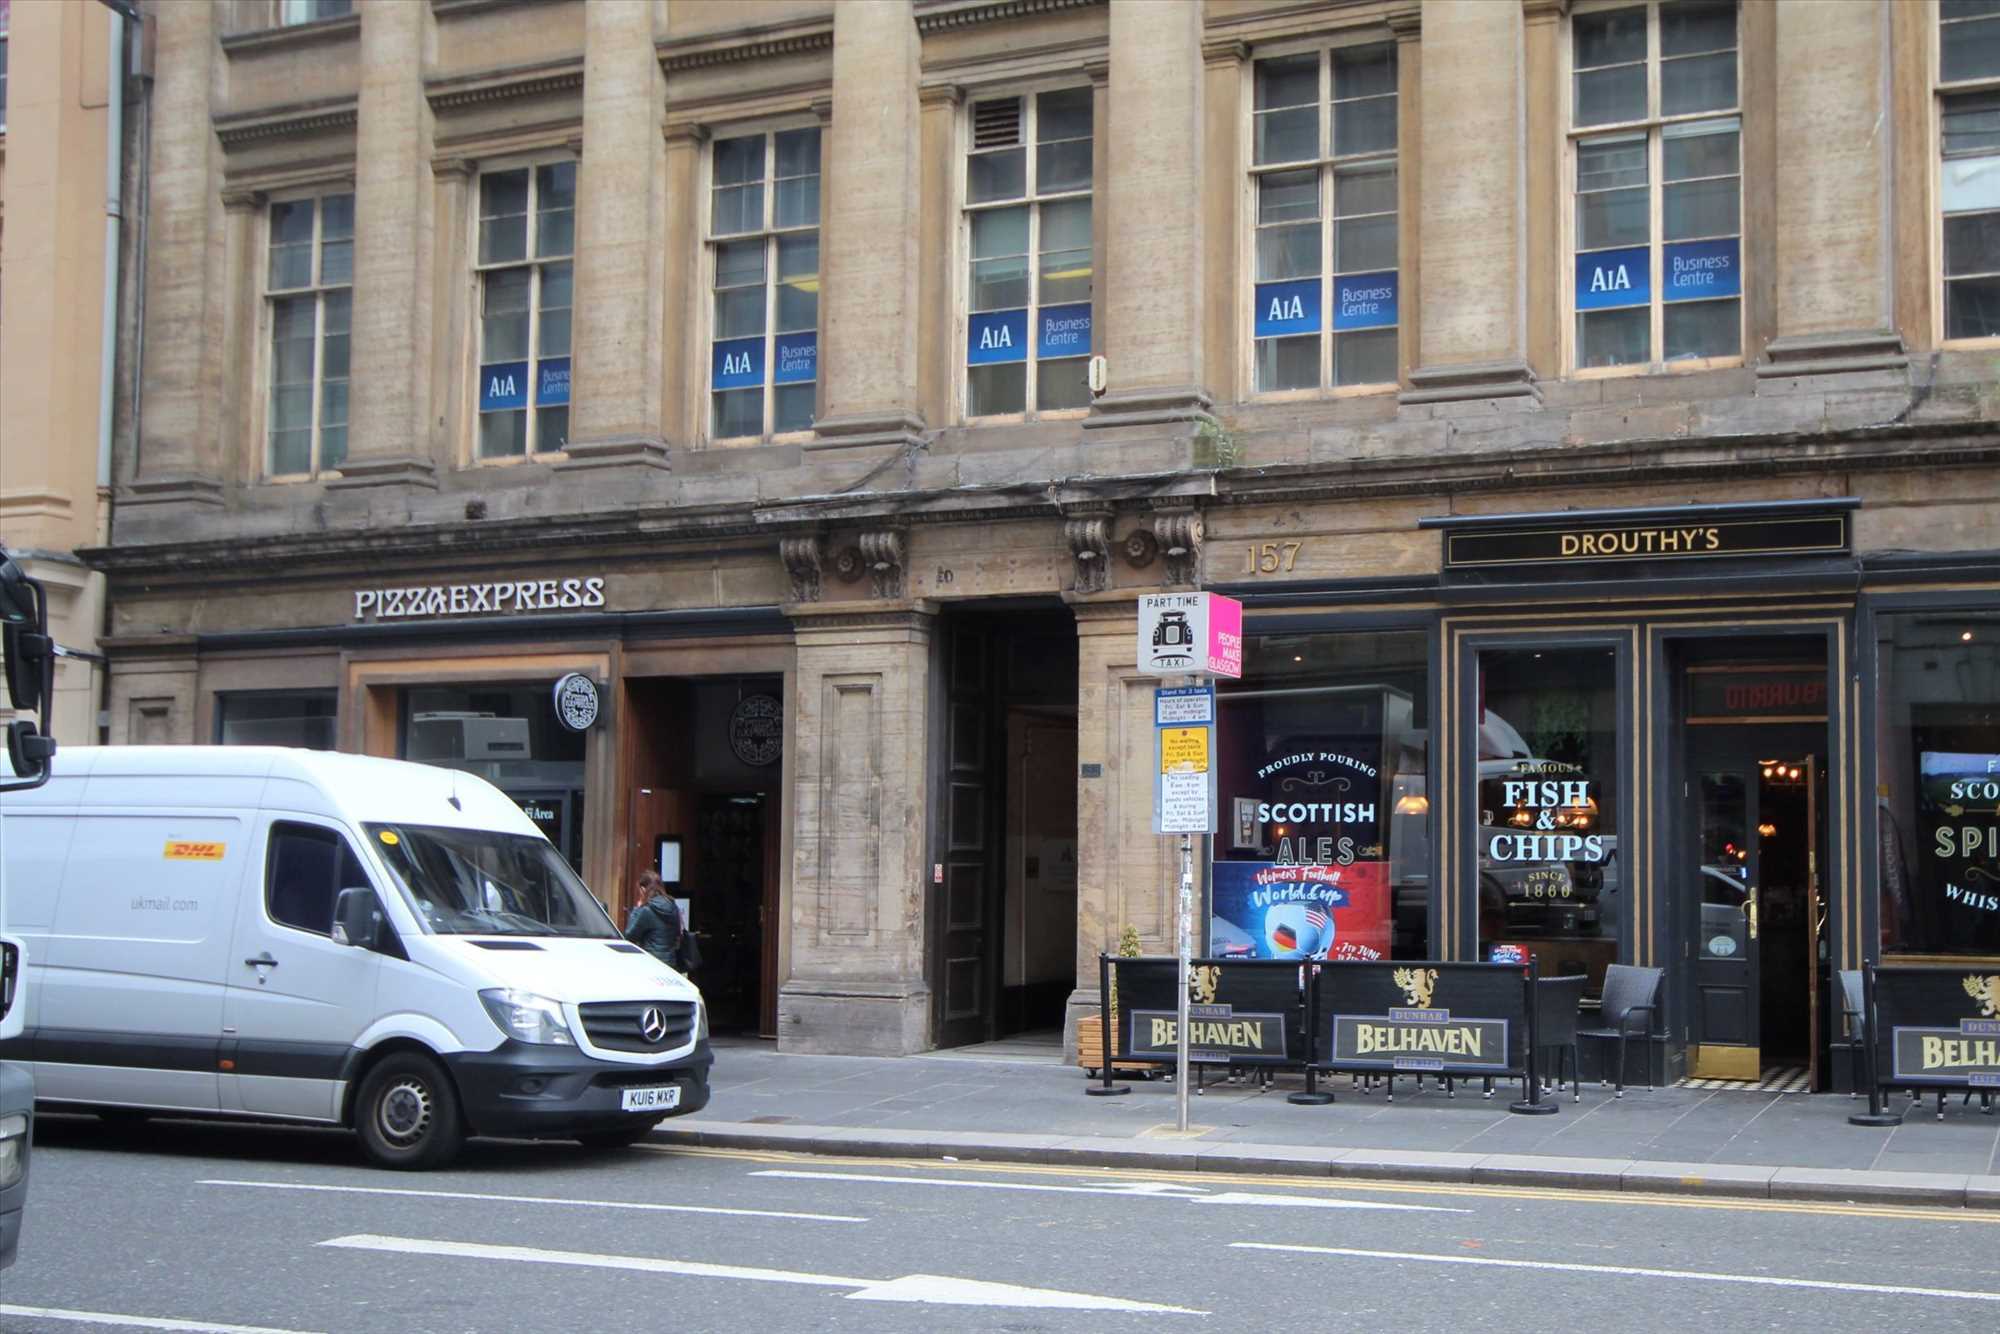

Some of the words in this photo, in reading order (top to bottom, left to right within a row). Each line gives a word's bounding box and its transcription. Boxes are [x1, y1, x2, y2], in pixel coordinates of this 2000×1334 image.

[1673, 255, 1730, 272] Business
[1673, 272, 1714, 287] Centre
[1342, 287, 1392, 302] Business
[1342, 301, 1379, 317] Centre
[1046, 318, 1090, 332] Business
[1045, 331, 1078, 345] Centre
[781, 345, 816, 359] Busines
[781, 358, 810, 372] Centre
[543, 369, 570, 381] Busine
[1561, 528, 1720, 555] DROUTHY'S
[1248, 542, 1303, 572] 157
[354, 578, 605, 618] PIZZAEXPRESS
[1147, 598, 1172, 608] PART
[1178, 596, 1199, 607] TIME
[1217, 631, 1241, 649] PEOPLE
[1222, 646, 1241, 661] MAKE
[1160, 658, 1185, 667] TAXI
[1209, 656, 1241, 673] GLASGOW
[1257, 752, 1315, 778] PROUDLY
[1320, 752, 1377, 778] POURING
[1520, 763, 1574, 773] FAMOUS
[1502, 781, 1590, 808] FISH
[1950, 782, 1999, 799] SCO
[533, 807, 554, 819] Area
[1258, 803, 1375, 823] SCOTTISH
[1536, 808, 1557, 830] &
[173, 843, 217, 856] DHL
[1490, 835, 1603, 861] CHIPS
[1935, 826, 1998, 858] SPI
[1275, 836, 1355, 866] ALES
[1256, 868, 1297, 885] Women's
[1300, 865, 1342, 883] Football
[1528, 871, 1566, 882] SINCE
[1253, 883, 1304, 907] World
[1524, 884, 1570, 898] 1860
[1946, 883, 1998, 911] WHIS
[130, 896, 199, 911] ukmail.com
[1357, 944, 1381, 960] JUNE
[1191, 1007, 1226, 1017] UNBAR
[1395, 1010, 1442, 1020] DUNBAR
[1151, 1018, 1263, 1049] BEHAVEN
[1968, 1022, 2000, 1033] DUN
[1356, 1024, 1482, 1056] BELHAVEN
[1922, 1036, 2000, 1070] BELH
[630, 1090, 655, 1106] KU16
[656, 1087, 675, 1104] MXR
